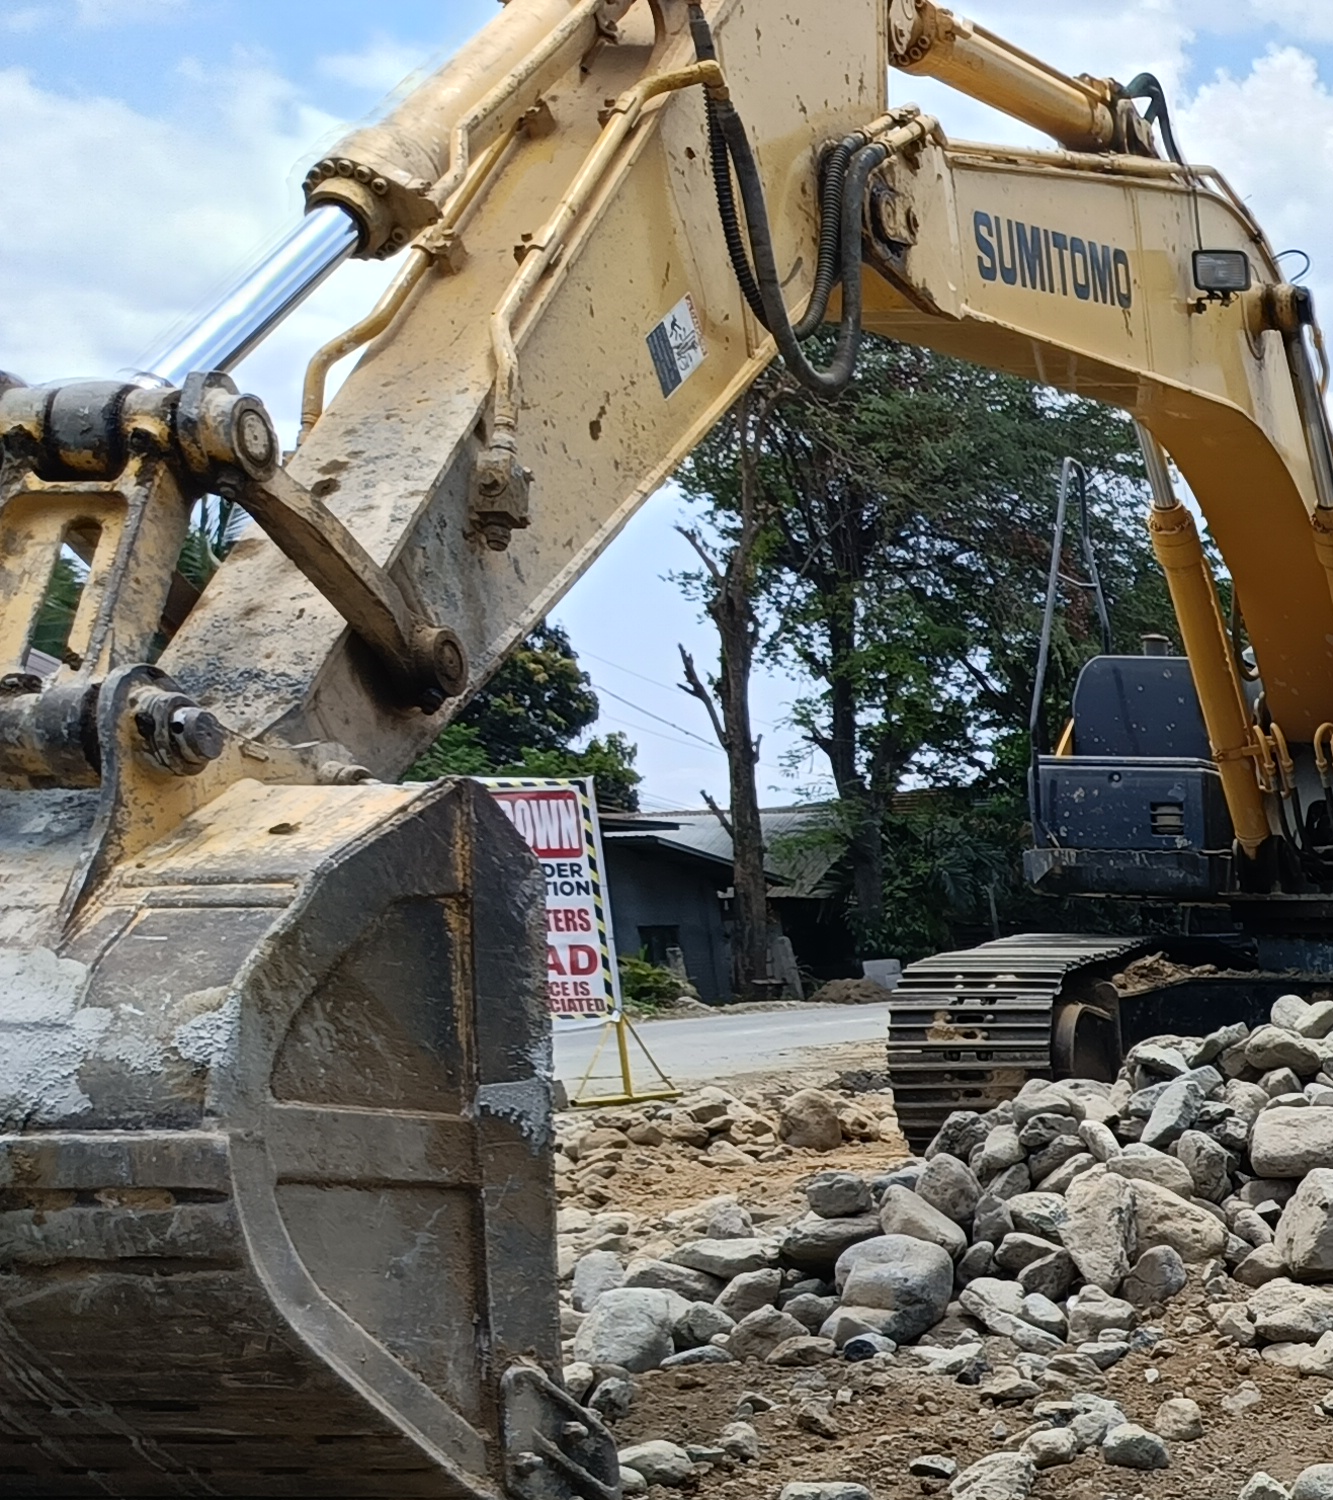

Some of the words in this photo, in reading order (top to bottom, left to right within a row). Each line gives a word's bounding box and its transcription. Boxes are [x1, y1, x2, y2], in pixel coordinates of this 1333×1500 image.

[974, 211, 1131, 309] SUMITOMO
[496, 799, 580, 849] OWN
[573, 981, 590, 996] IS
